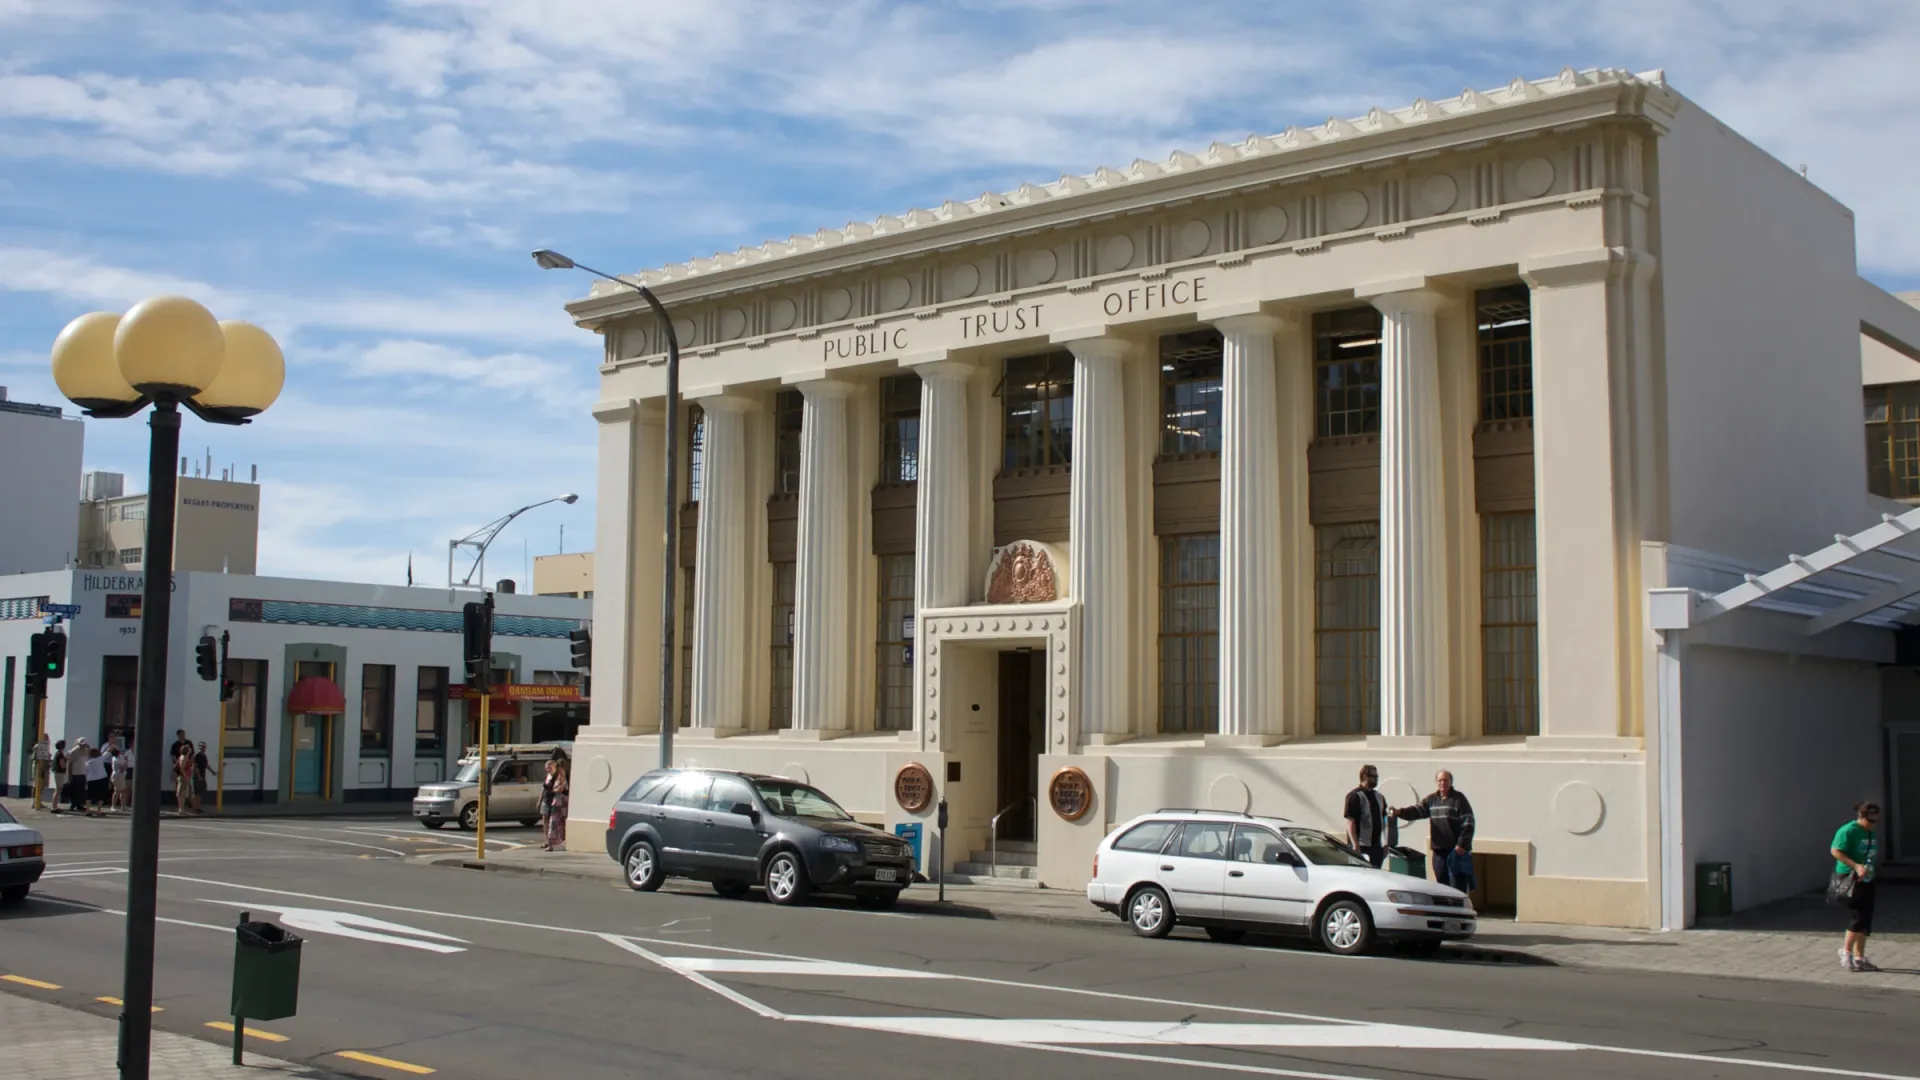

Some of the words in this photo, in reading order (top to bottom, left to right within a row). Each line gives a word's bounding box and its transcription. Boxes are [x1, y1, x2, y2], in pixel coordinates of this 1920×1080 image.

[824, 328, 908, 362] PUBLIC
[960, 304, 1045, 339] TRUST
[1103, 277, 1208, 317] OFFICE
[211, 501, 255, 511] PROPERTIES
[84, 574, 177, 593] HILDEBRAS
[546, 687, 572, 697] INDIAN
